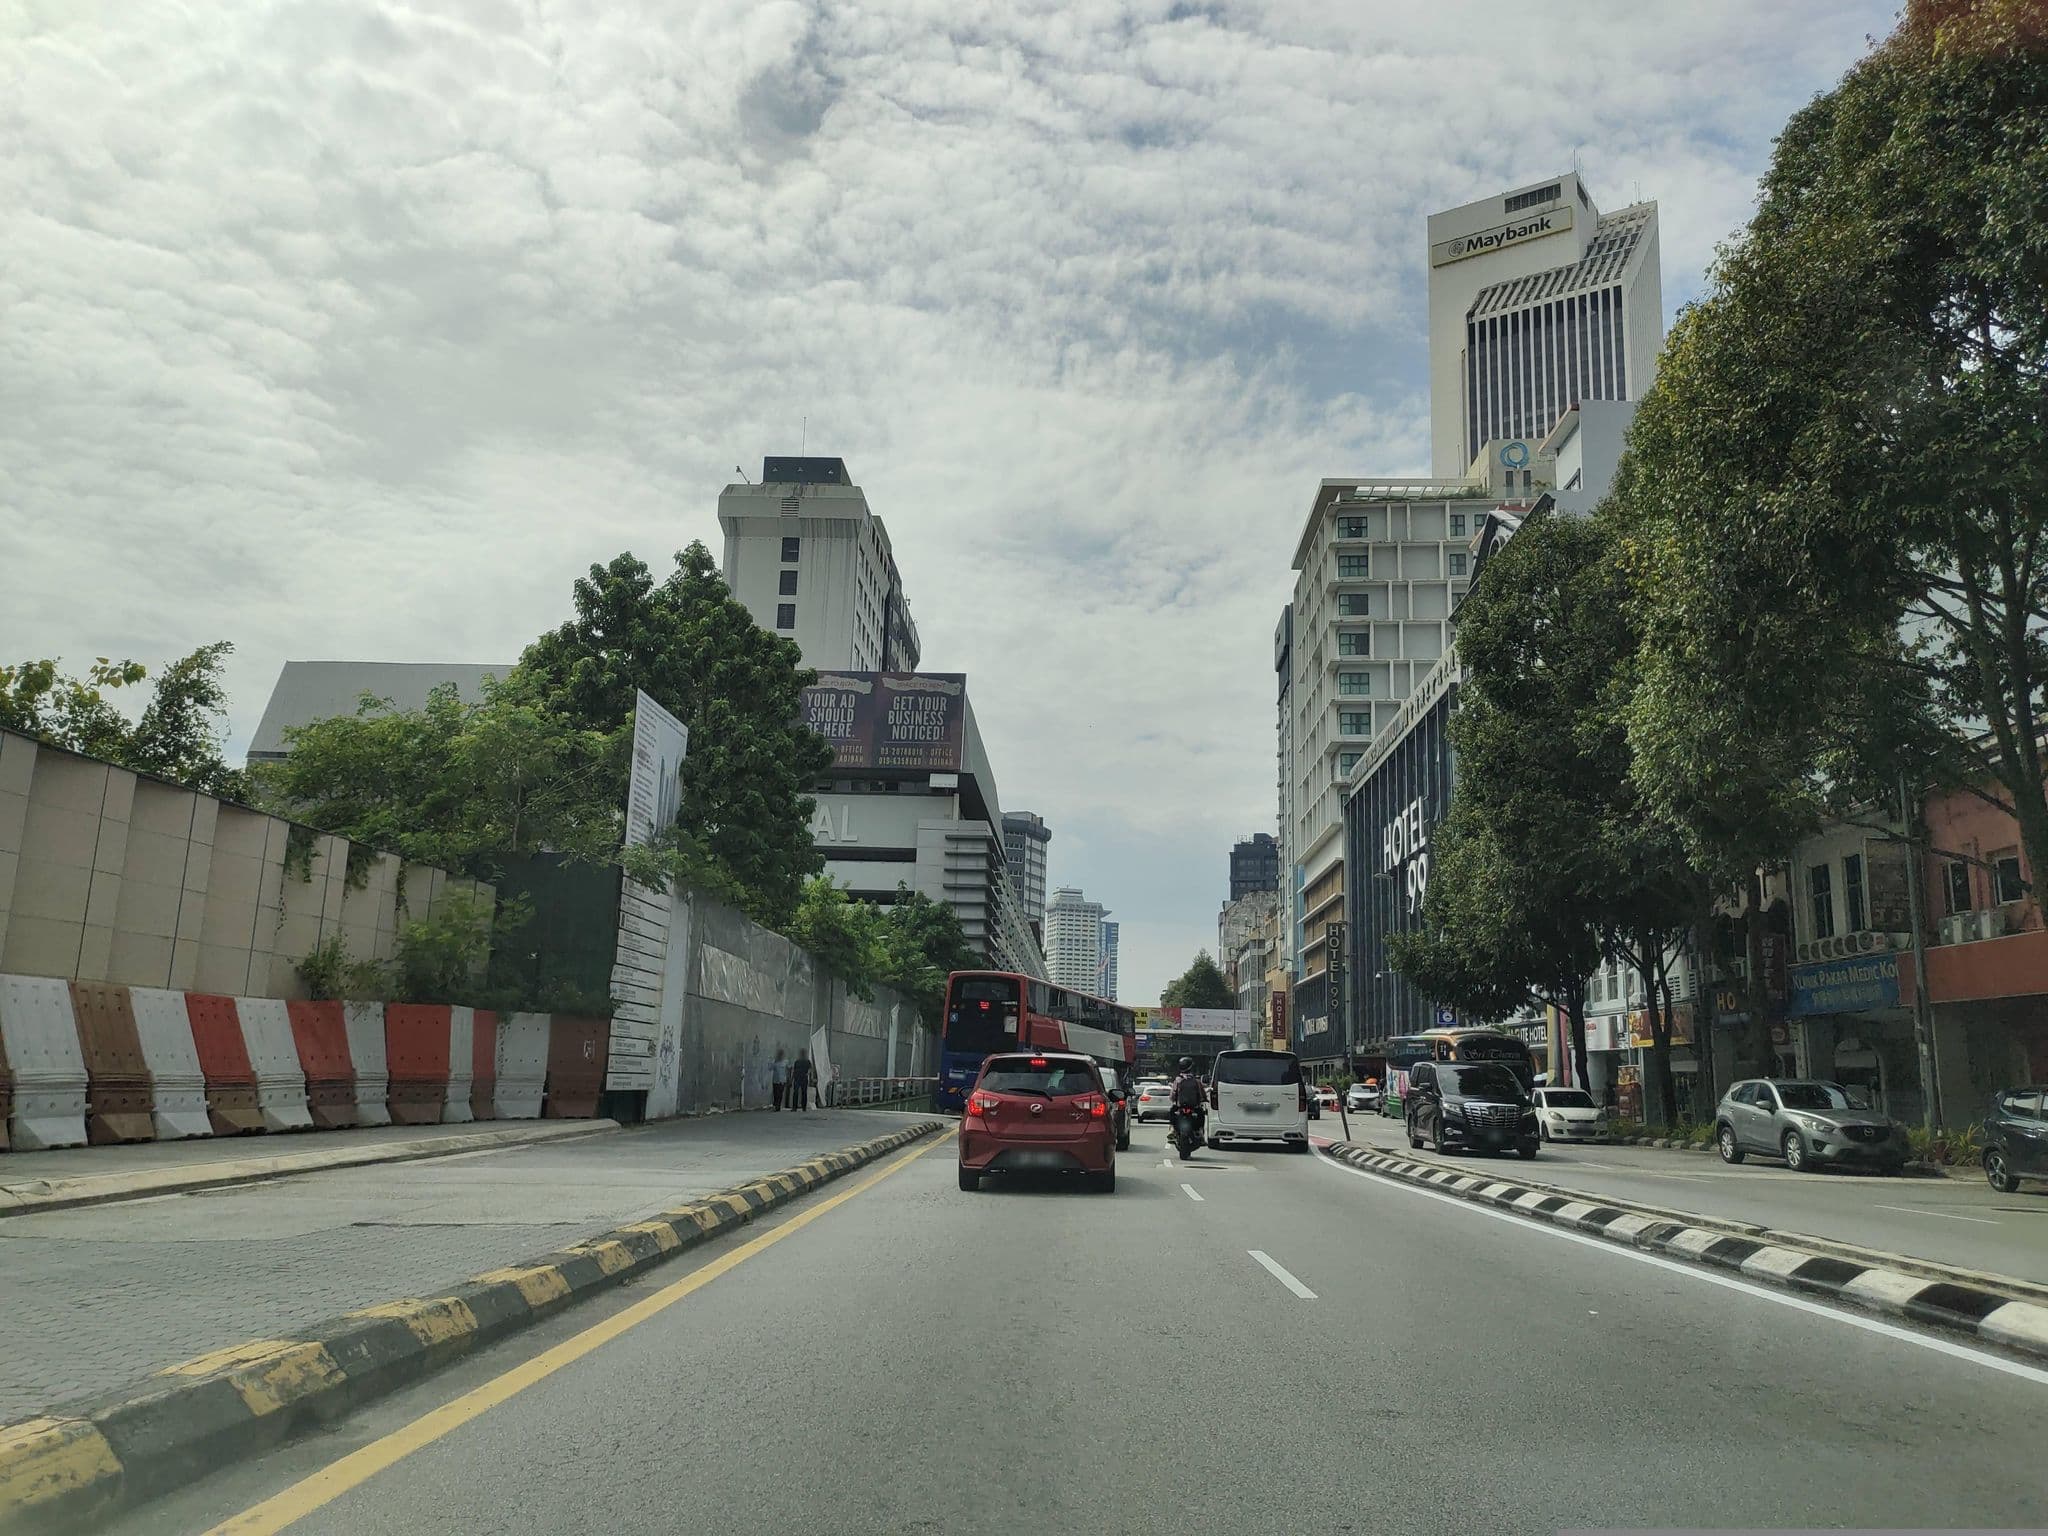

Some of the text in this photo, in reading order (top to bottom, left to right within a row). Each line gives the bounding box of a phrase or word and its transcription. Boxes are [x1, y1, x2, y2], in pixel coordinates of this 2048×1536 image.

[1466, 217, 1552, 252] Maybank
[807, 693, 855, 709] YOUR AD
[893, 696, 947, 712] GET YOUR
[810, 707, 854, 722] SHOULD
[888, 711, 944, 725] BUSINESS
[824, 723, 855, 738] HERE.
[892, 726, 944, 741] NOTICED!
[1384, 796, 1426, 873] HOTEL
[1408, 853, 1428, 914] 99
[1329, 926, 1340, 1009] HOTEL 99
[1529, 1026, 1547, 1041] HOTEL
